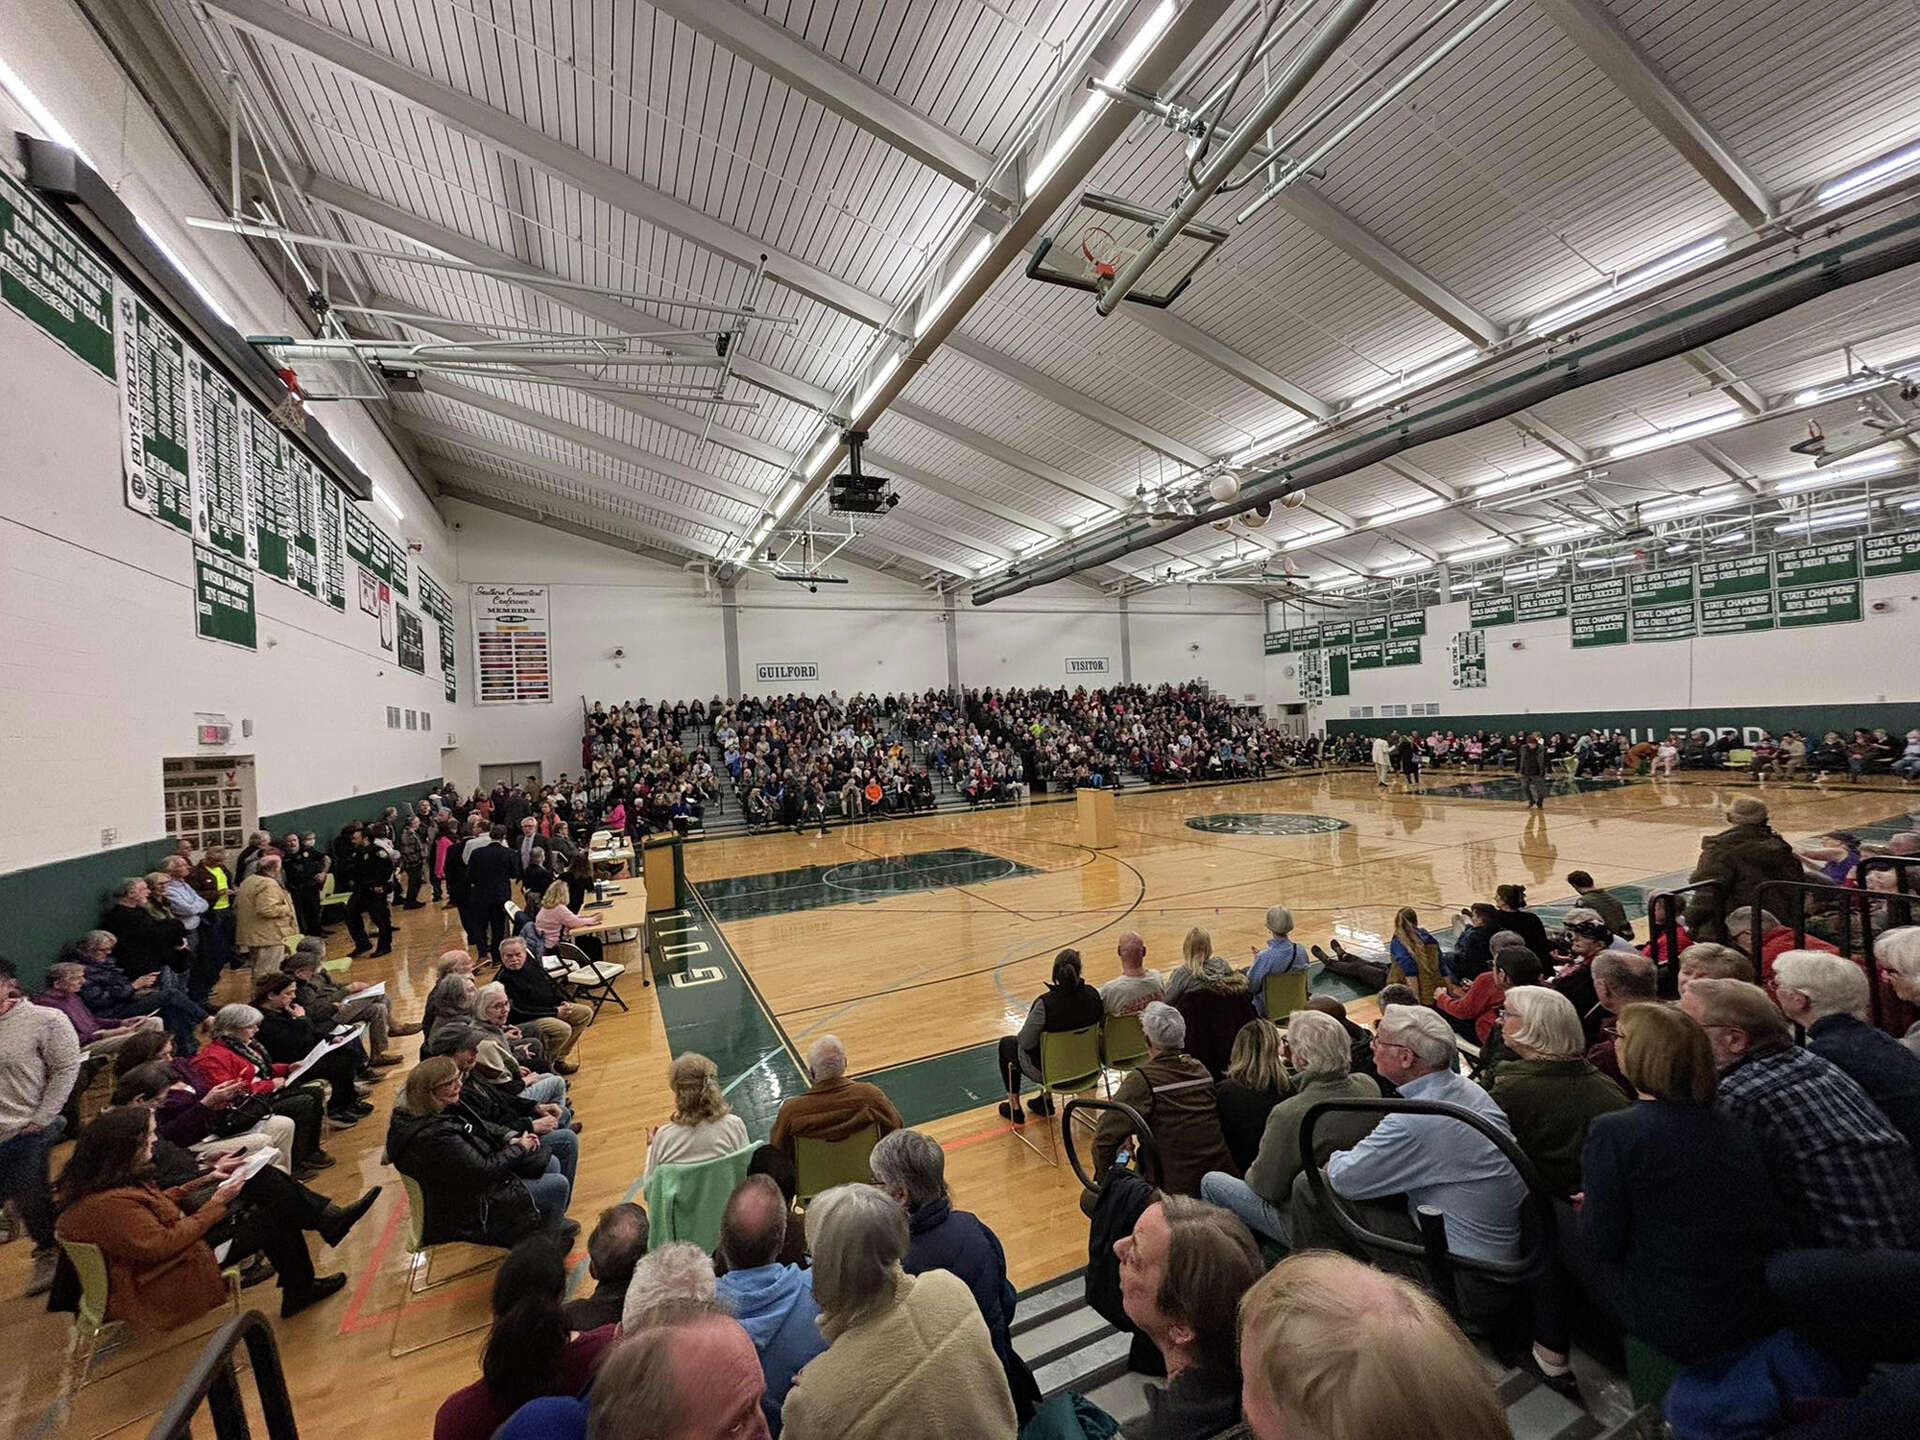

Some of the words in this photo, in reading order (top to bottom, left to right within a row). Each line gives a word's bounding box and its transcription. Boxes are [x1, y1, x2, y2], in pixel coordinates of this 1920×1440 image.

[4, 229, 37, 273] BOYS
[40, 261, 112, 334] BASKETBALL
[123, 329, 138, 411] SOCCER
[128, 411, 141, 467] BOYS
[1866, 536, 1896, 548] STATE
[1778, 551, 1797, 561] STATE
[1799, 549, 1816, 558] OPEN
[1818, 542, 1854, 555] CHAMPIONS
[1867, 547, 1902, 558] BOYS
[1700, 564, 1717, 573] STATE
[1736, 556, 1768, 568] CHAMPIONS
[1784, 561, 1800, 570] BOYS
[1663, 568, 1691, 579] CHAMPIONS
[475, 586, 504, 595] Southern
[507, 587, 544, 596] Connecticut
[1573, 585, 1589, 593] STATE
[1591, 579, 1623, 590] CHAMPIONS
[1536, 589, 1564, 598] CHAMPIONS
[1575, 592, 1593, 601] BOYS
[1594, 588, 1622, 598] SOCCER
[1782, 591, 1807, 600] STATE
[1808, 585, 1856, 598] CHAMPIONS
[493, 596, 528, 607] Conference
[1486, 597, 1512, 606] CHAMPIONS
[1704, 601, 1725, 610] STATE
[1727, 595, 1769, 607] CHAMPIONS
[1786, 601, 1803, 610] BOYS
[1635, 610, 1654, 618] STATE
[1656, 605, 1692, 617] CHAMPIONS
[1393, 618, 1422, 627] BASEBALL
[1574, 618, 1591, 626] STATE
[1592, 613, 1625, 623] CHAMPIONS
[1576, 625, 1594, 633] BOYS
[1595, 622, 1623, 632] SOCCER
[1071, 660, 1104, 671] VISITOR
[759, 666, 816, 678] GUILFORD
[1591, 727, 1764, 746] ILFORD
